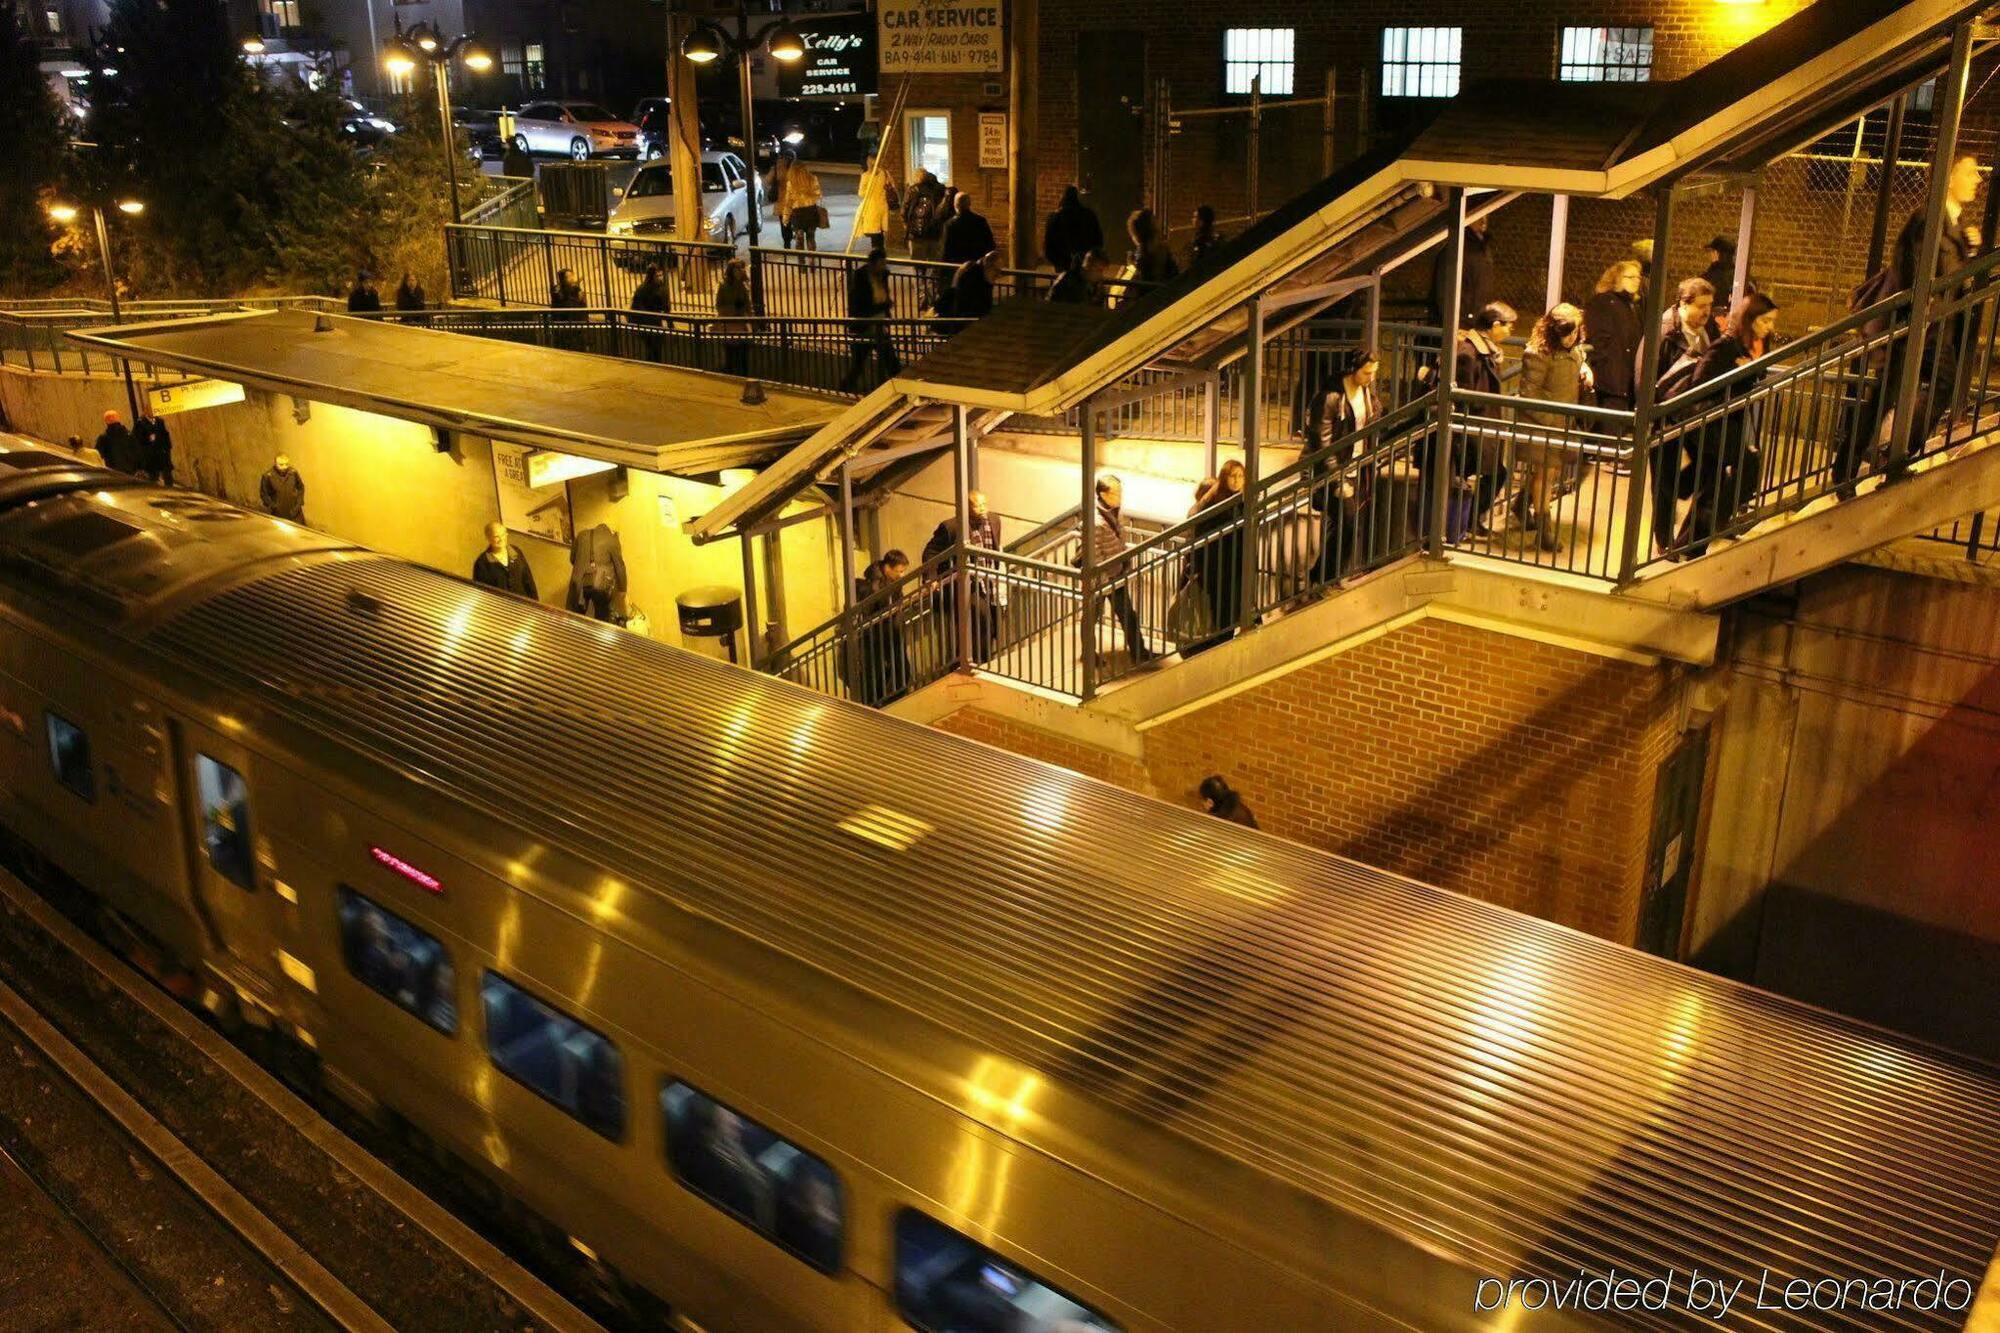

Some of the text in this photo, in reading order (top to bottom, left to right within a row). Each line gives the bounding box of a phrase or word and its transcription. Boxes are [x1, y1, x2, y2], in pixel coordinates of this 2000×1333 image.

[884, 8, 997, 28] CAR SERVICE
[799, 33, 863, 51] Kelly's
[891, 33, 900, 47] 2
[816, 58, 838, 66] CAR
[805, 68, 850, 77] SERVICE
[801, 83, 857, 95] 229-4141
[160, 389, 172, 403] B
